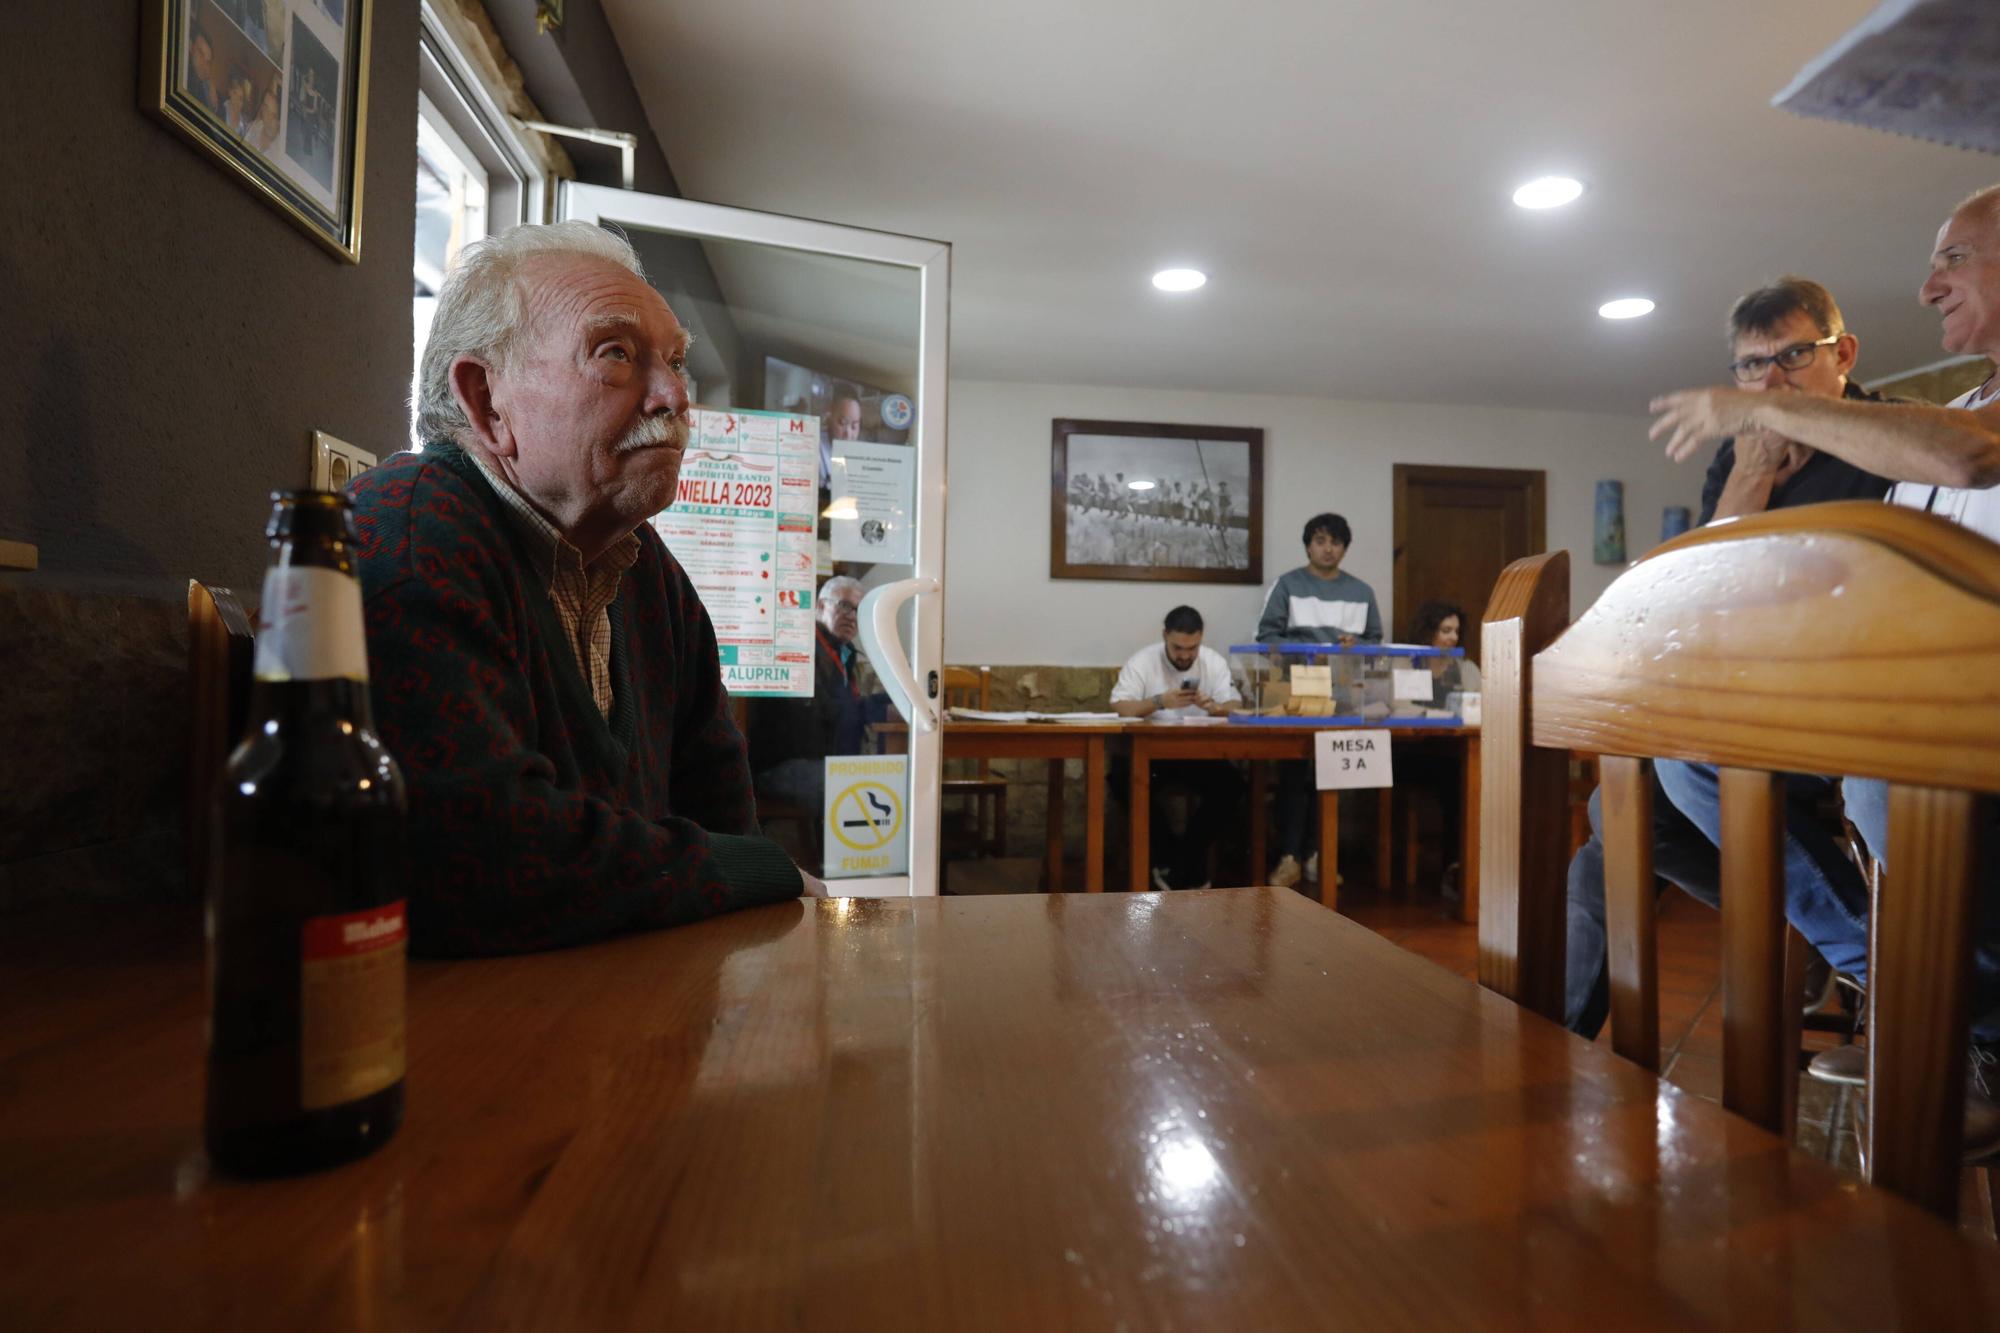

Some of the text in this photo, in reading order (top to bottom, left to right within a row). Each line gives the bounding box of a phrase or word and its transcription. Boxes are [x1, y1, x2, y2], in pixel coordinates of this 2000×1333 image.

[698, 461, 739, 471] FIESTAS
[737, 474, 771, 483] SANTO
[677, 479, 772, 508] NIELLA 2023
[728, 668, 790, 681] ALUPRIN
[1331, 739, 1376, 752] MESA
[829, 761, 904, 775] PROHIBIDO
[1341, 757, 1368, 771] 3 A
[841, 855, 891, 870] FUMAR
